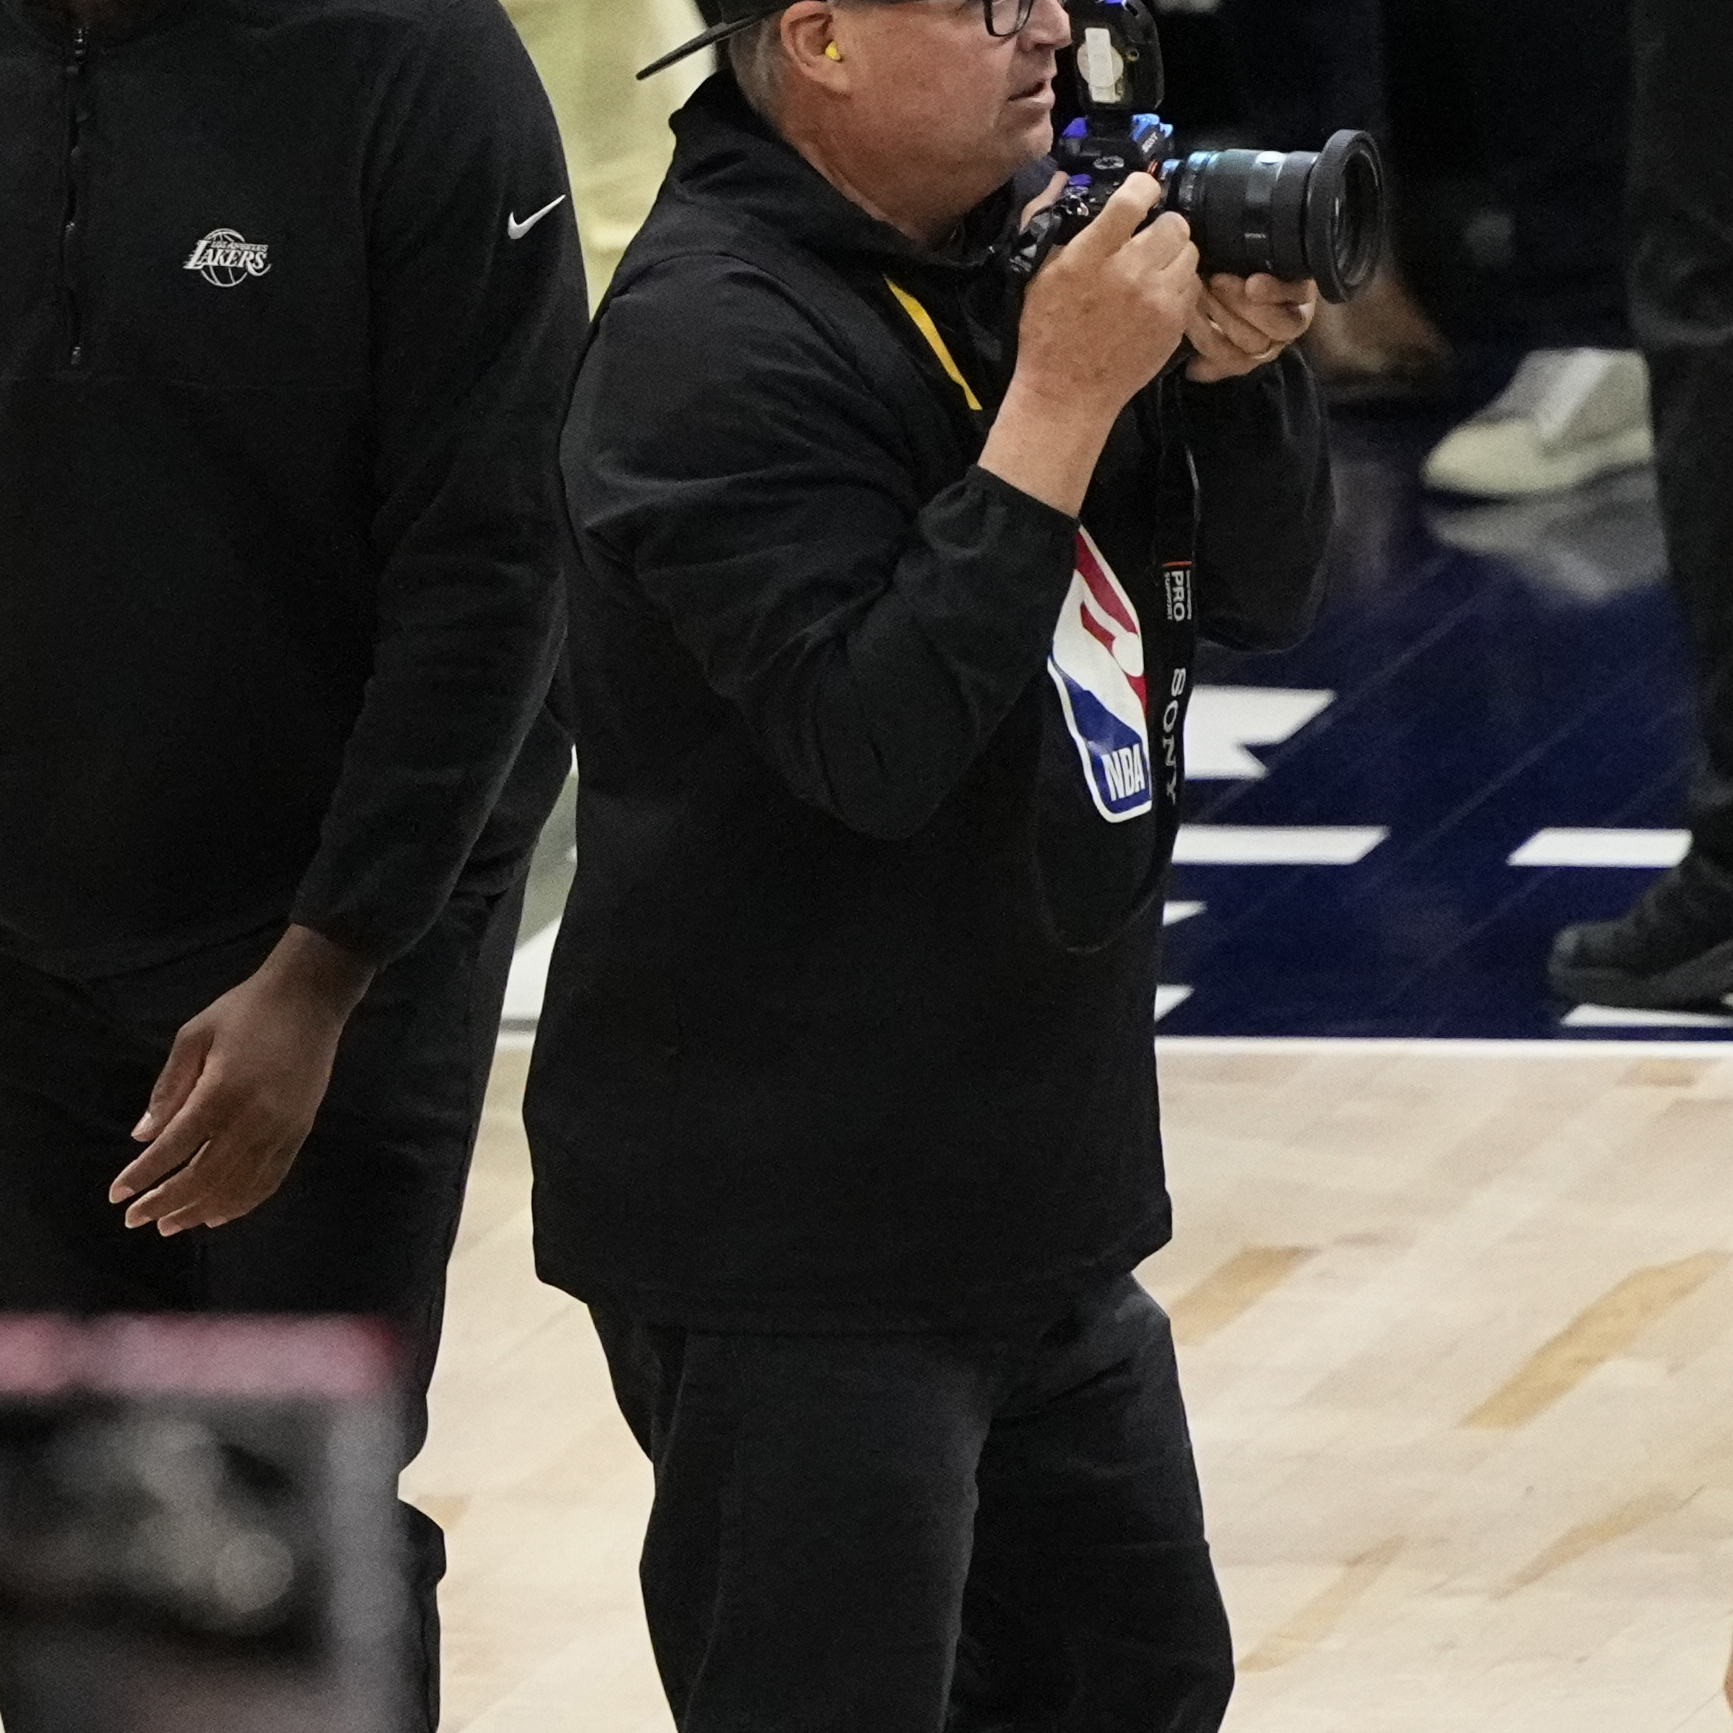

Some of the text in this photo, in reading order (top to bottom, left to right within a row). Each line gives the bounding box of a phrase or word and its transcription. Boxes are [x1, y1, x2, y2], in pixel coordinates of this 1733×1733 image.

[183, 239, 272, 277] LAKERS
[1170, 570, 1186, 622] PRO
[1162, 667, 1187, 805] SONY
[1101, 743, 1146, 802] NBA
